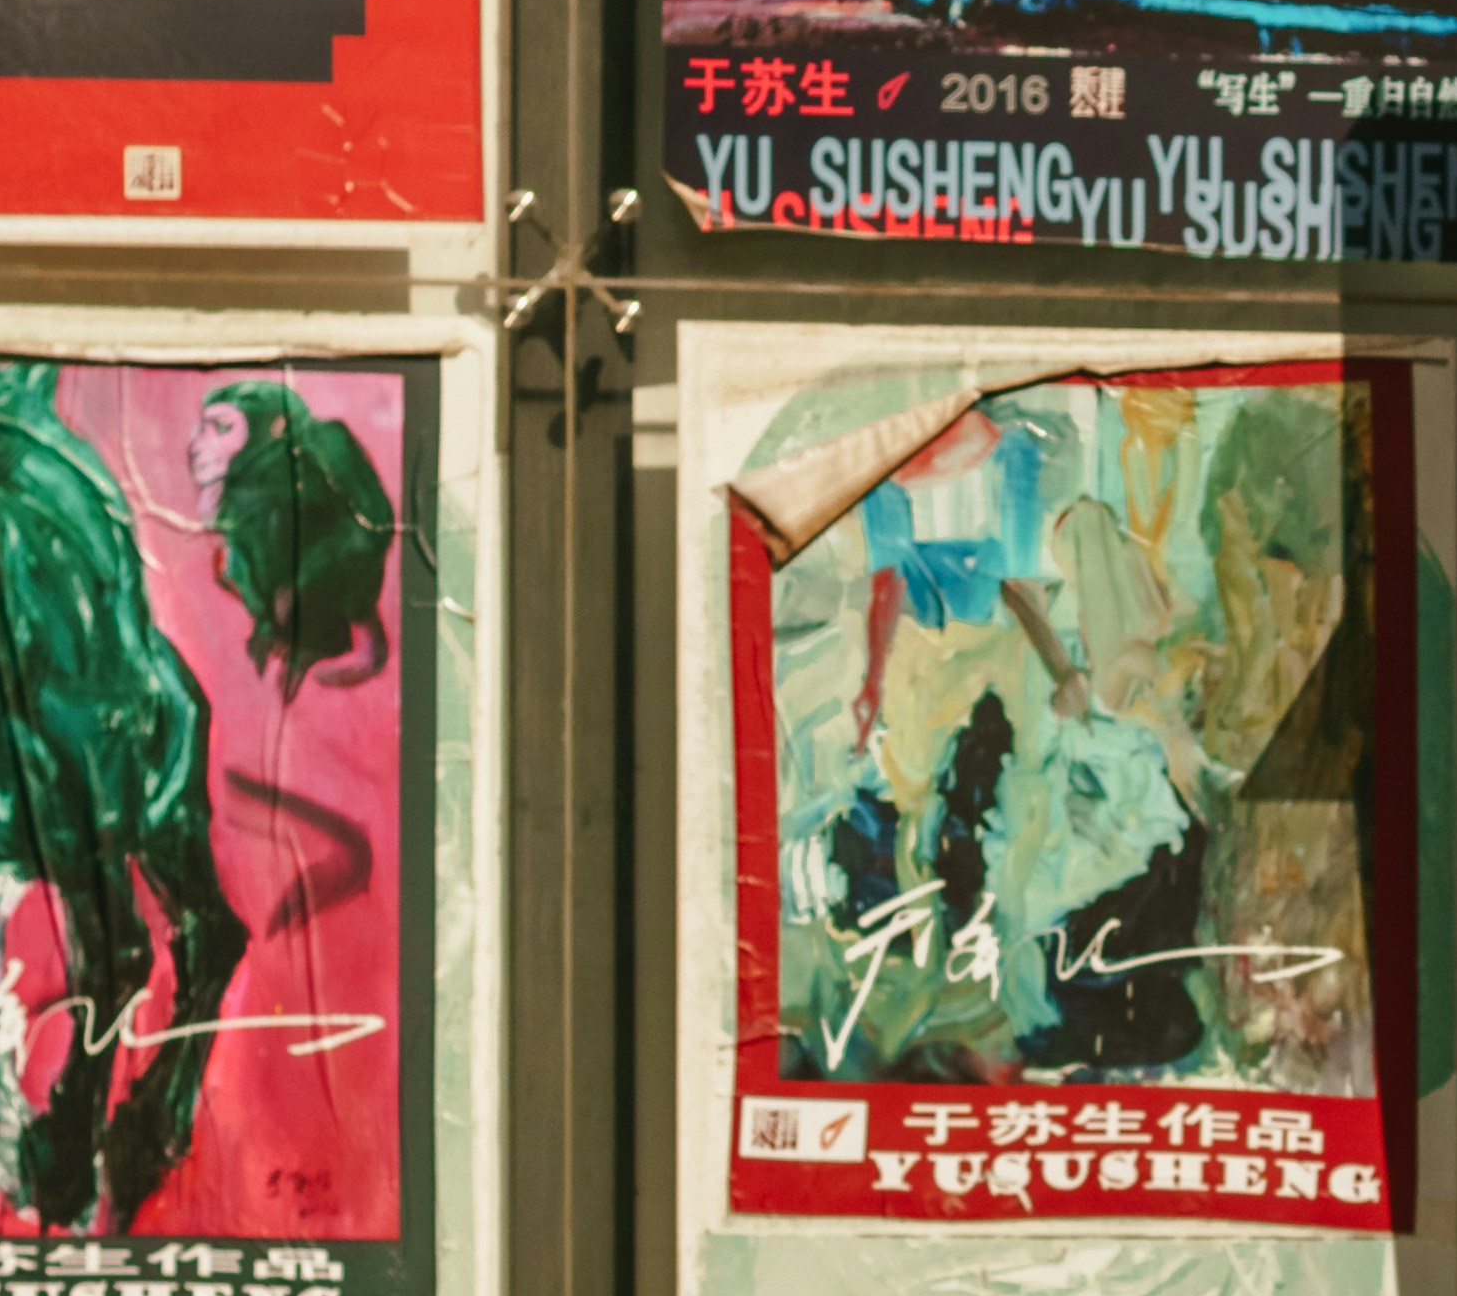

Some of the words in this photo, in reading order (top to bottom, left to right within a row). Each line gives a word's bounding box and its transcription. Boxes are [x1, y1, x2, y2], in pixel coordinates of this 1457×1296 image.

[685, 58, 855, 117] 于苏生
[940, 73, 1051, 114] 2016
[696, 134, 773, 216] YU
[810, 136, 1074, 223] SUSHENG
[903, 1102, 1325, 1154] 于苏生作品
[868, 1149, 1382, 1205] YUSUSHENG
